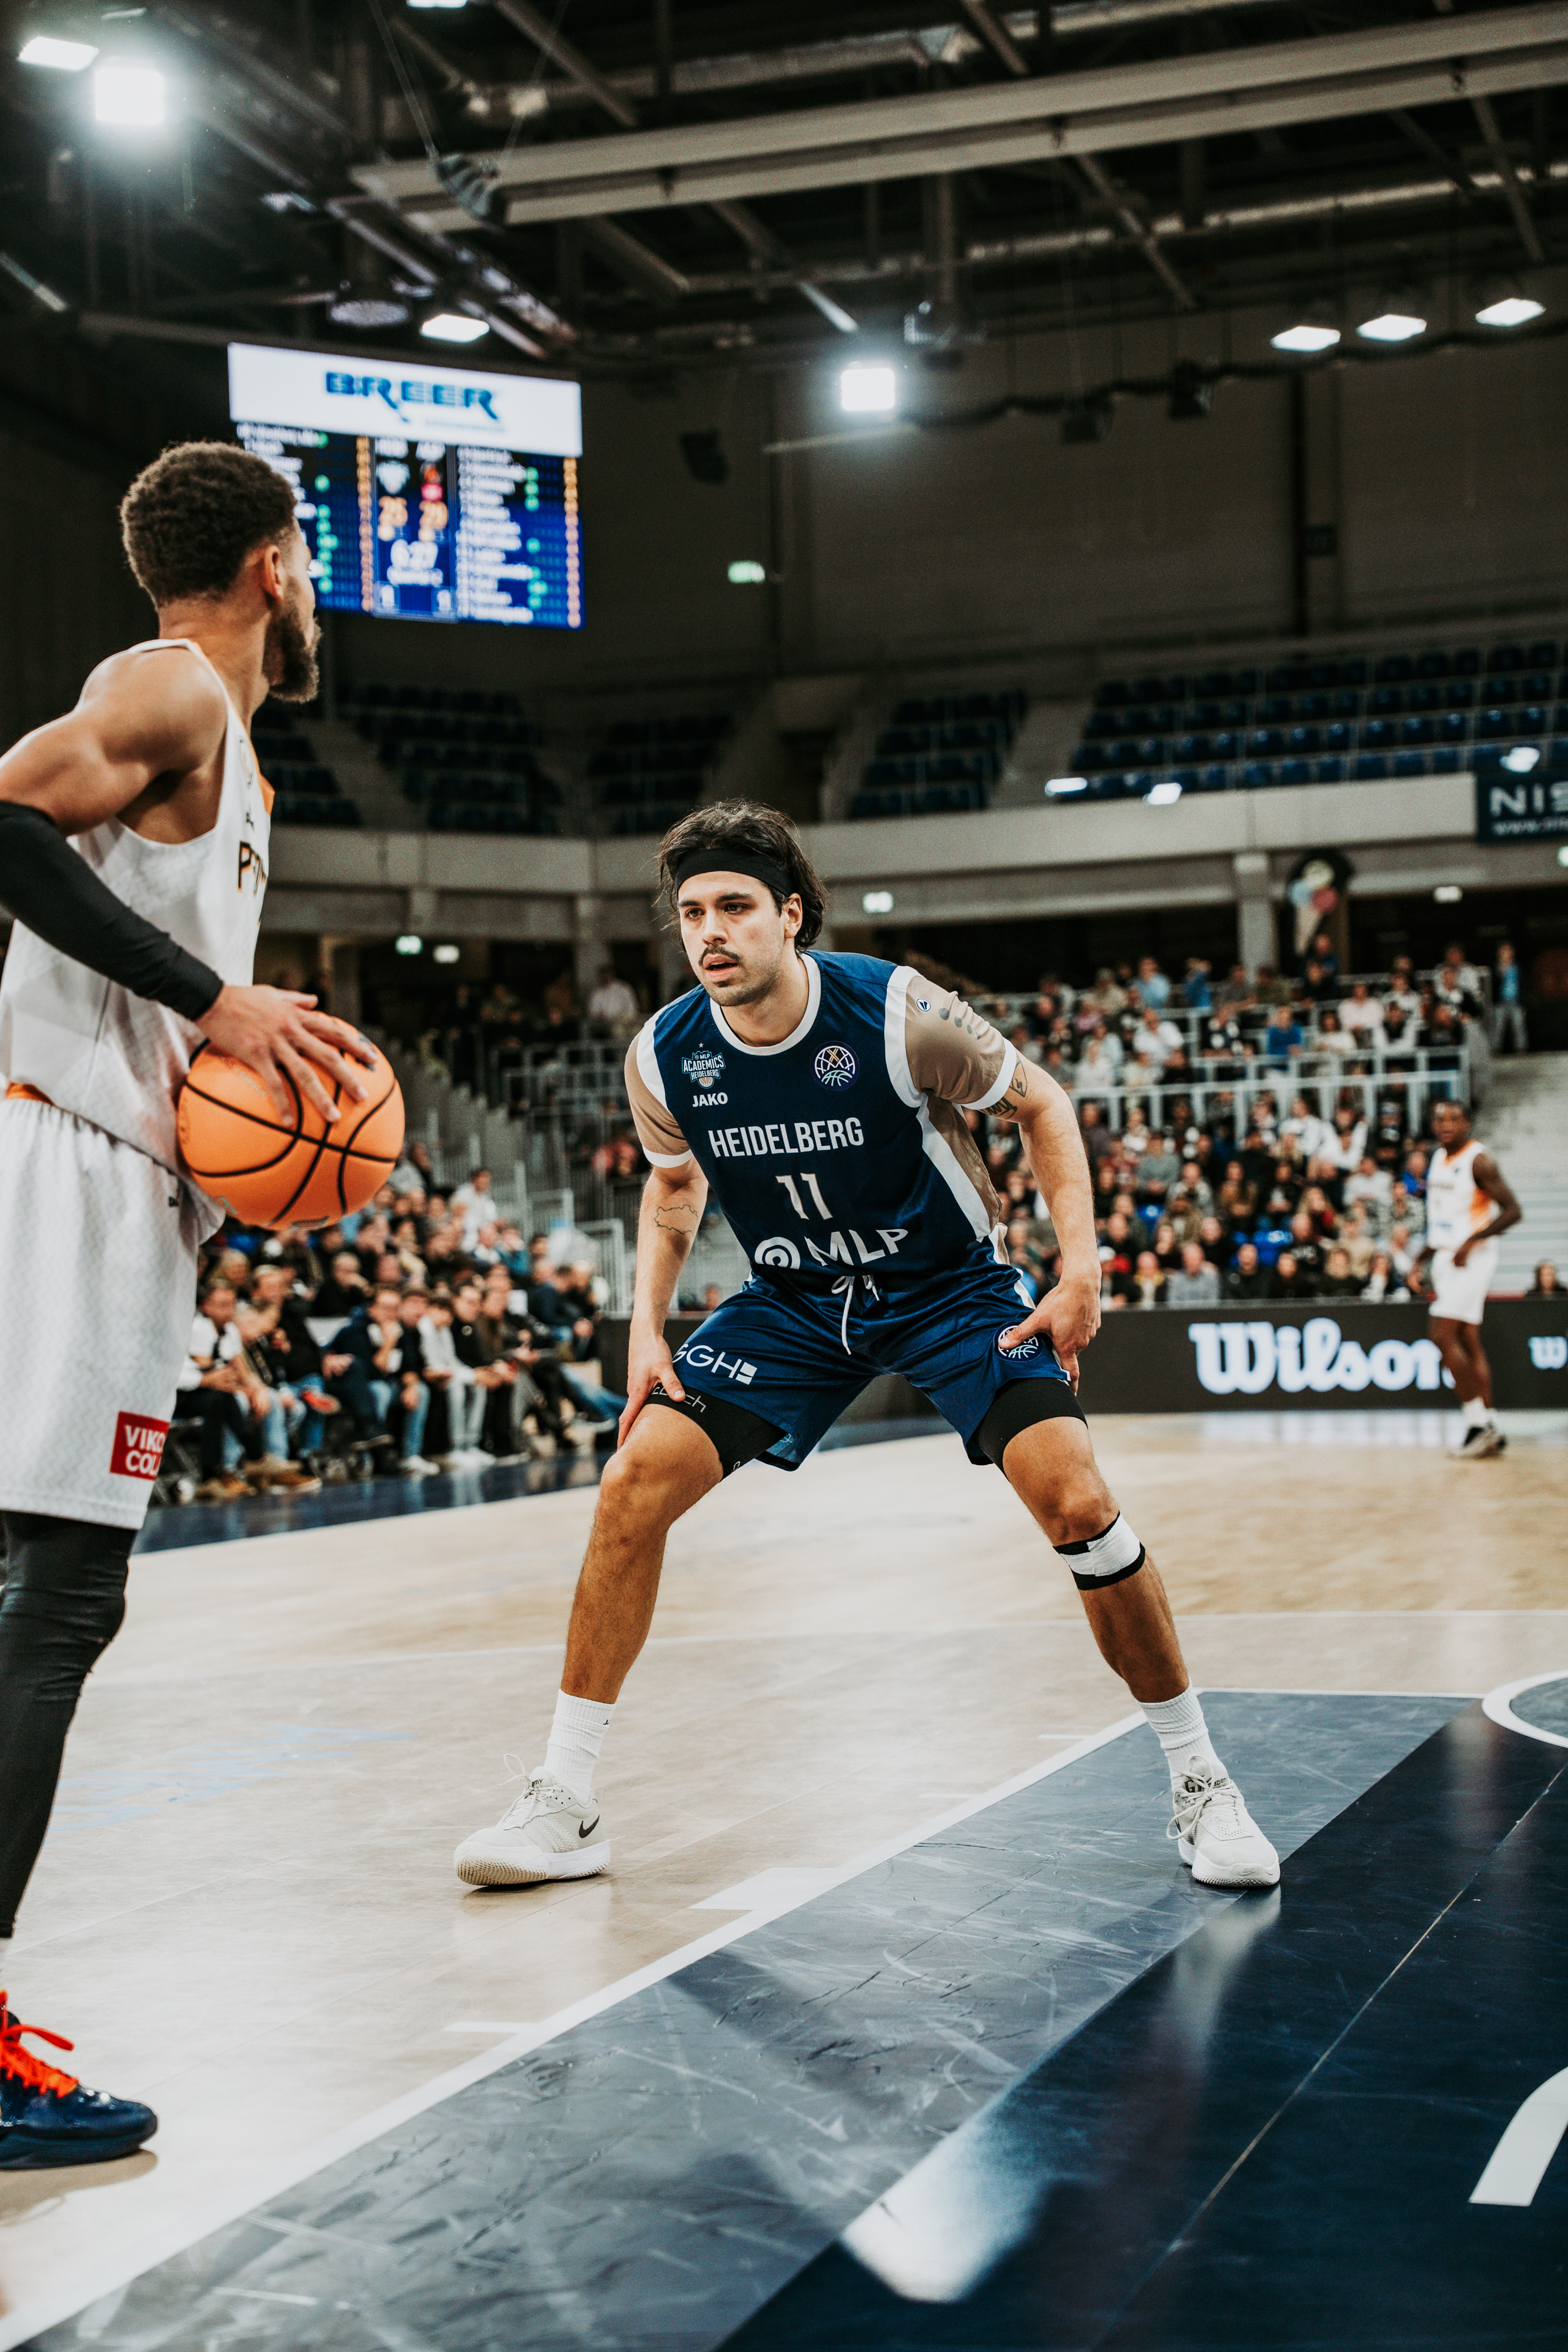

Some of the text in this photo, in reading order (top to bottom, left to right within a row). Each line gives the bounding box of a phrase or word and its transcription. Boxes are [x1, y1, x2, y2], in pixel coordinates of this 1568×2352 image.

[325, 372, 499, 420] BREER
[683, 1054, 724, 1073] ACADEMICS
[690, 1069, 719, 1081] HEIDELBERG
[692, 1092, 728, 1107] JAKO
[708, 1117, 864, 1158] HEIDELBERG
[775, 1172, 833, 1220] 11
[804, 1228, 908, 1267] MLP
[672, 1344, 742, 1378] GGH
[1188, 1317, 1456, 1394] Wilson
[125, 1449, 162, 1476] COL
